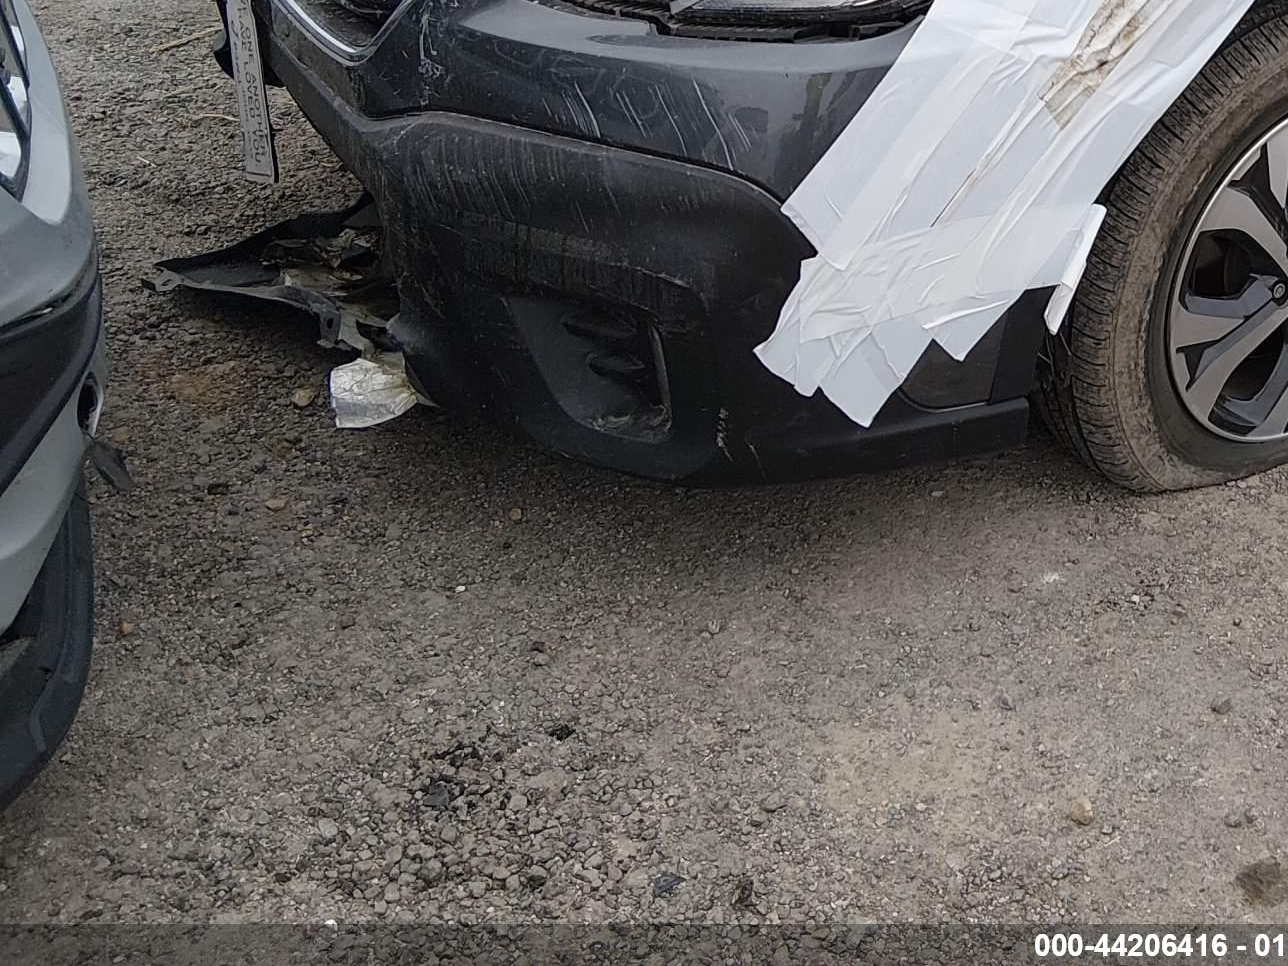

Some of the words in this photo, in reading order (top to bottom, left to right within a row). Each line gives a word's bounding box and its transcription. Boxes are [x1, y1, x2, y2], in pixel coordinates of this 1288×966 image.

[236, 8, 247, 51] HAVE
[243, 61, 256, 118] LOVED
[244, 27, 255, 62] ONE
[250, 74, 266, 156] ANOTHER
